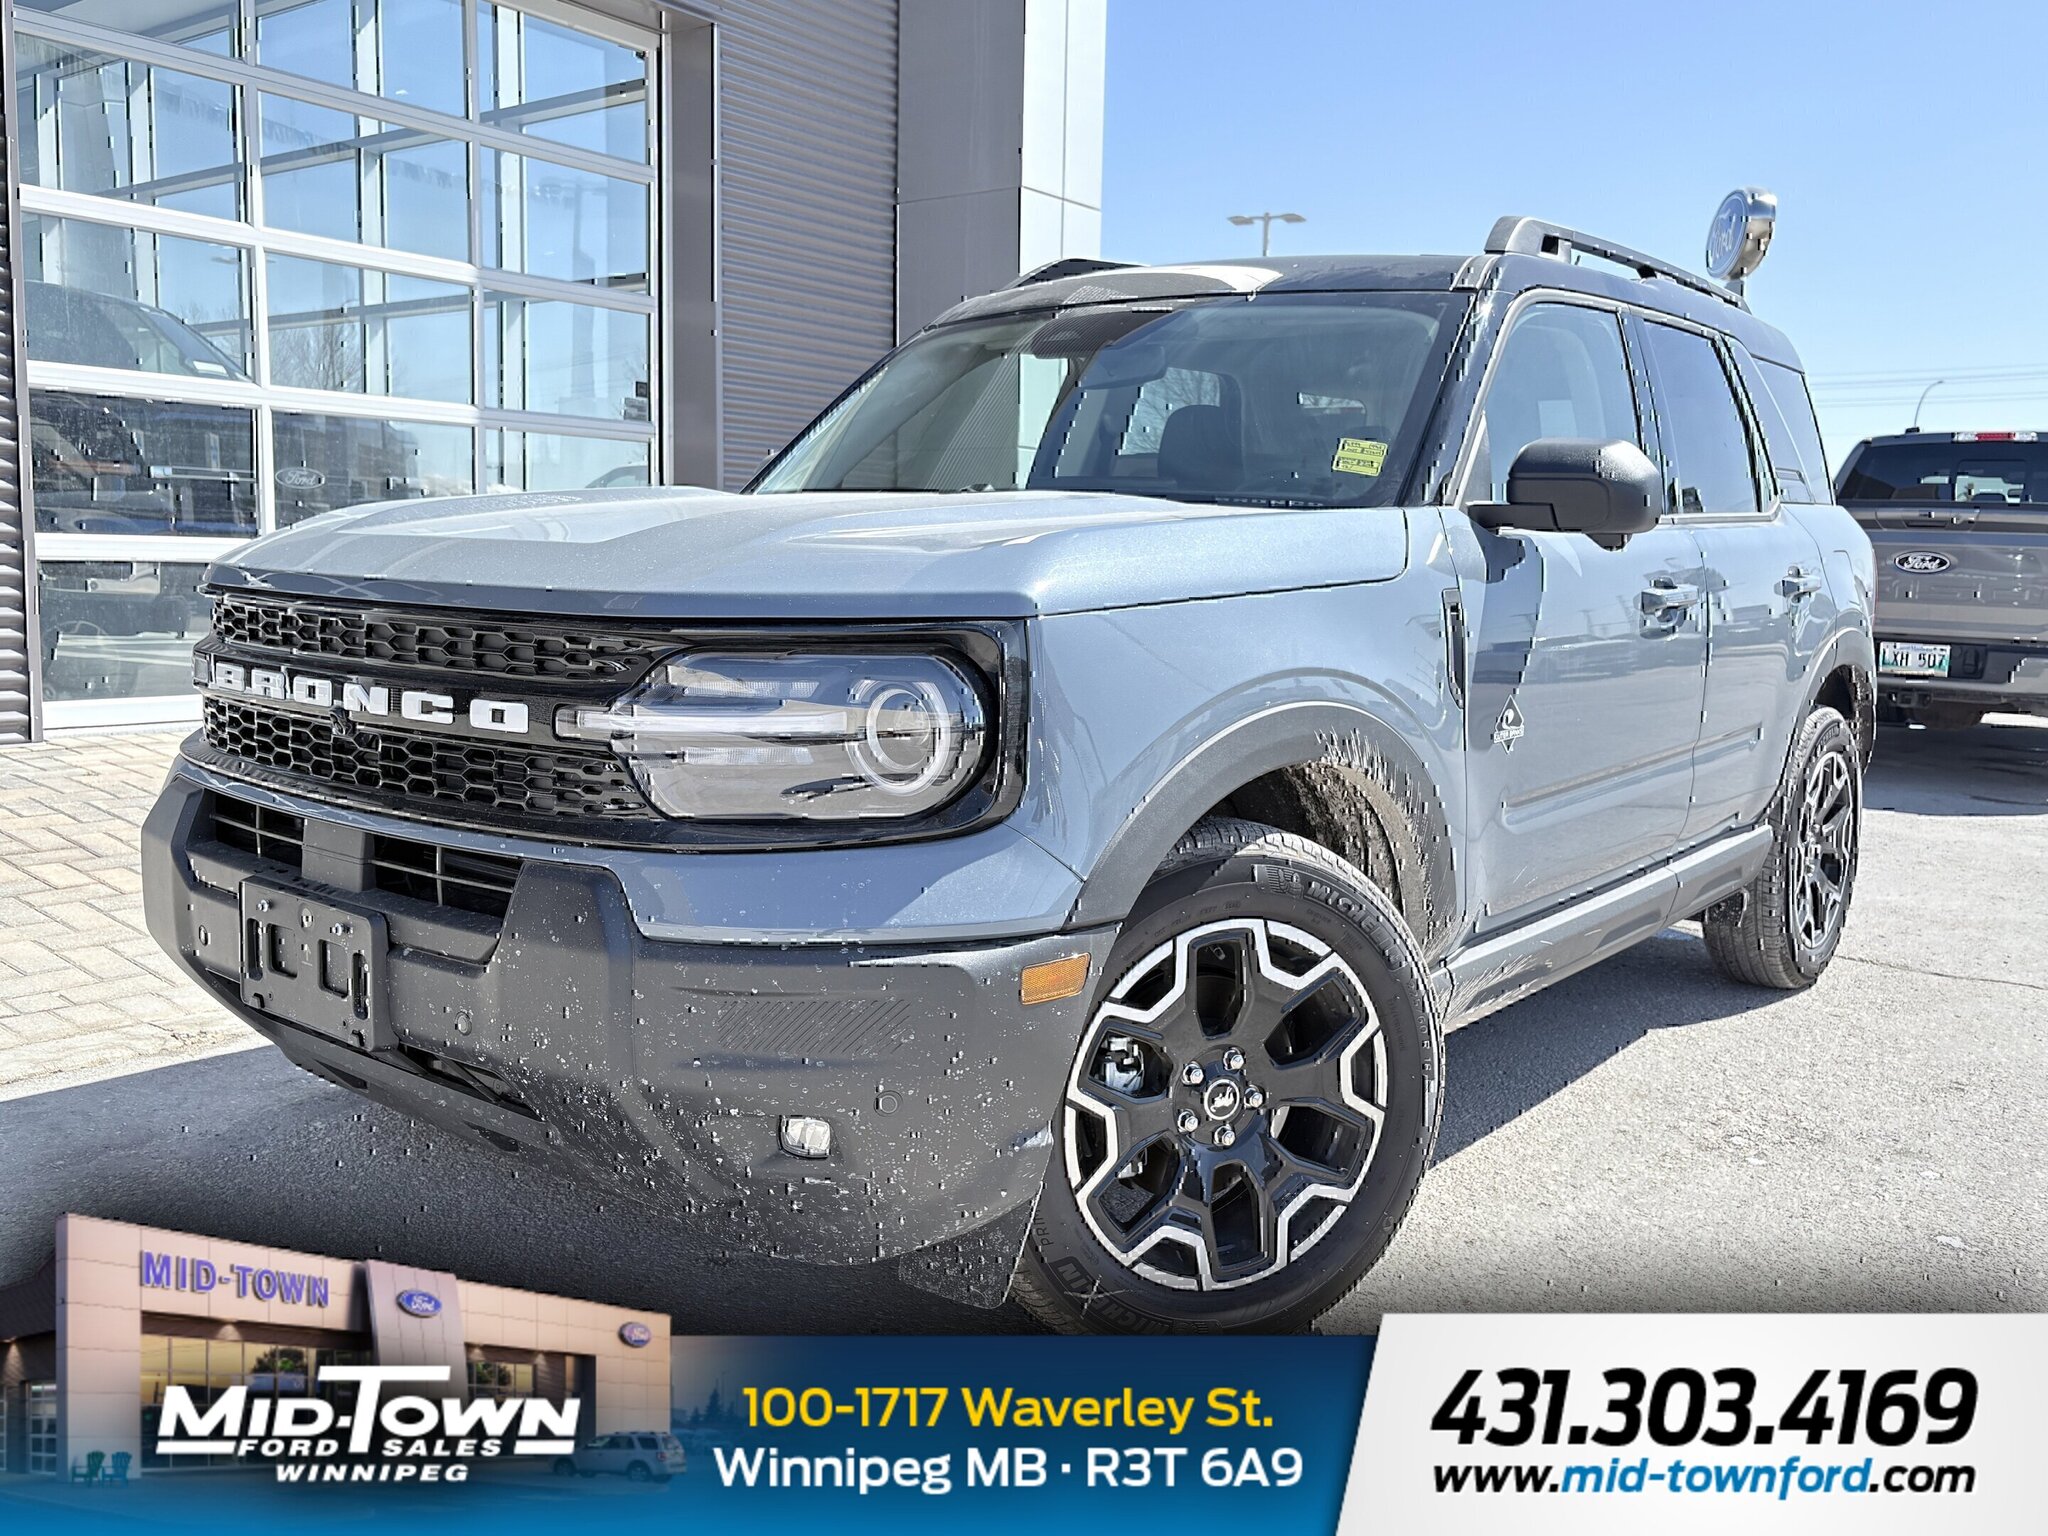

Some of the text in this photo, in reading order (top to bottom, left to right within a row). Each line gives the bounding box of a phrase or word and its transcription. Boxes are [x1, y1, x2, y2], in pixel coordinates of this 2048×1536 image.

[1903, 553, 1940, 571] Ford
[1882, 648, 1909, 667] LXH
[1918, 652, 1947, 669] 507
[215, 661, 530, 734] BRONCO
[1309, 881, 1405, 969] MICHELIN
